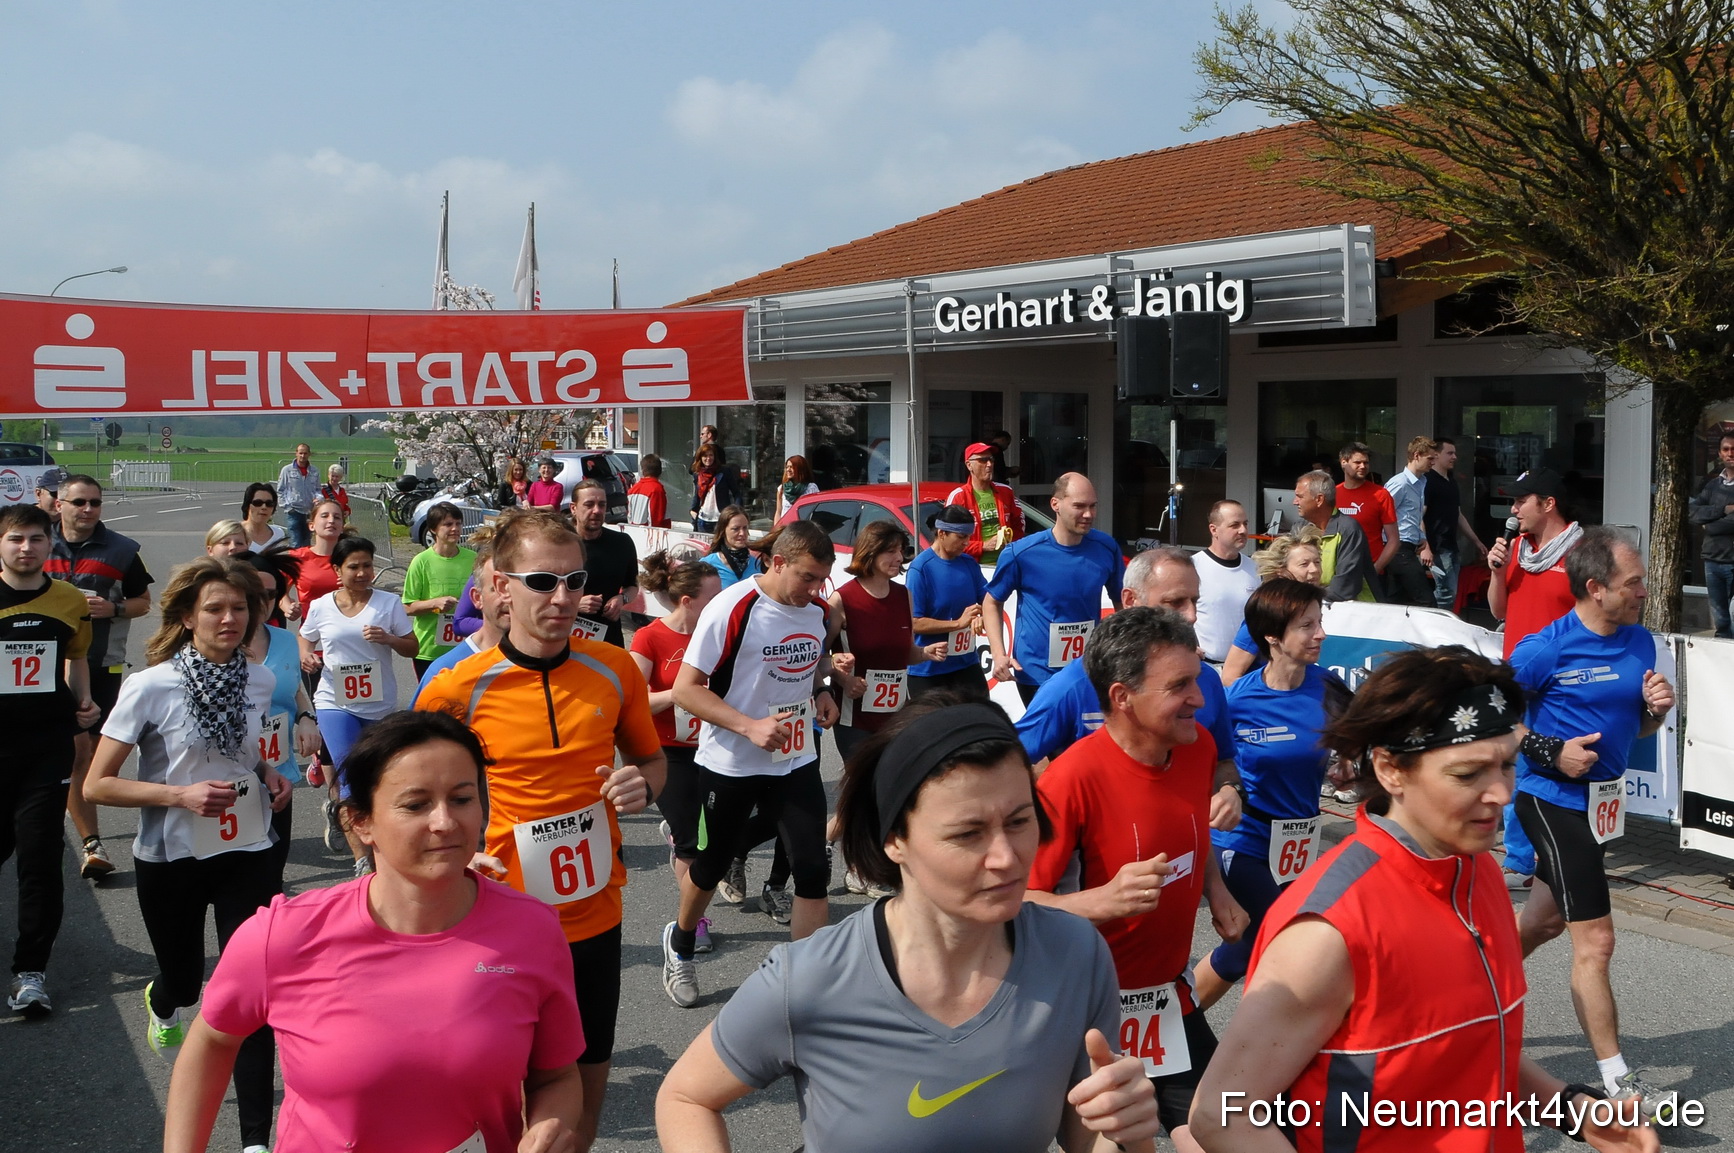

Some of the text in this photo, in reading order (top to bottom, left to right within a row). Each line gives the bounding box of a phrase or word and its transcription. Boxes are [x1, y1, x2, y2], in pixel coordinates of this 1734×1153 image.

[935, 271, 1250, 333] Gerhart & Jänig
[13, 620, 42, 628] saller
[762, 641, 812, 656] GERHART
[955, 631, 971, 653] 99
[1061, 635, 1085, 661] 79
[12, 656, 41, 687] 12
[344, 674, 373, 700] 95
[873, 683, 900, 708] 25
[1599, 783, 1618, 793] MEYER
[532, 816, 577, 836] MEYER
[1282, 822, 1309, 830] MEYER
[1596, 798, 1620, 837] 68
[533, 826, 579, 843] WERBUNG
[549, 838, 596, 896] 61
[1278, 838, 1311, 877] 65
[1120, 991, 1154, 1006] MEYER
[1119, 1014, 1166, 1066] 94
